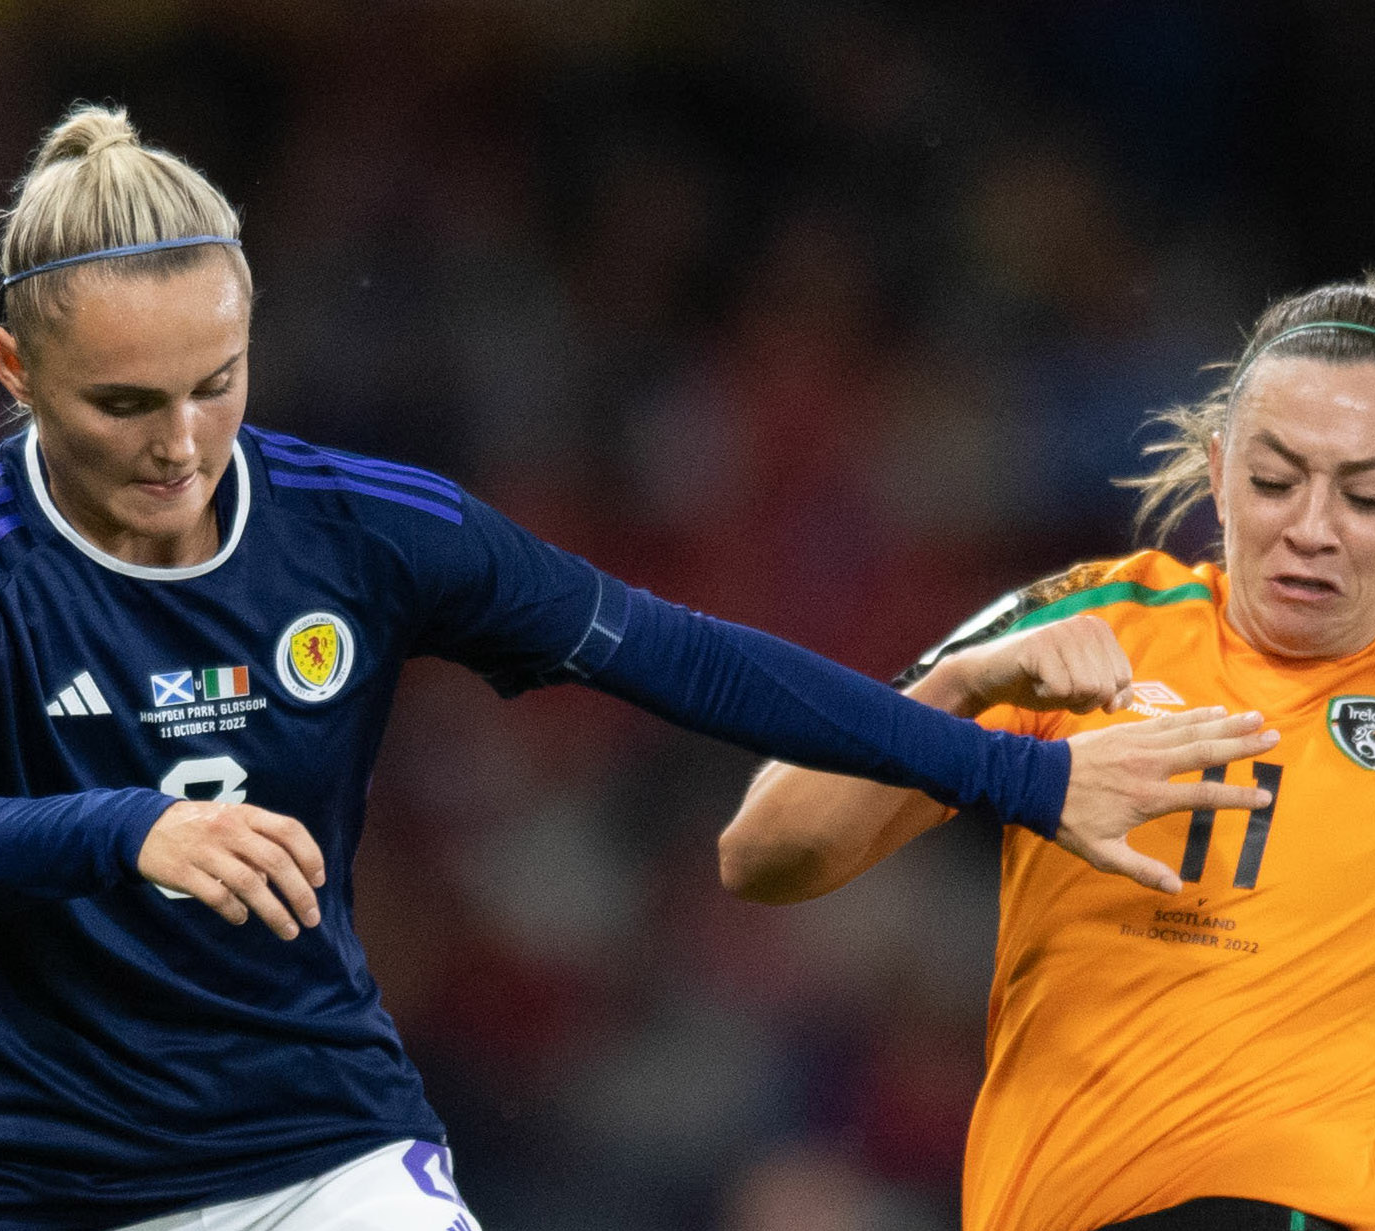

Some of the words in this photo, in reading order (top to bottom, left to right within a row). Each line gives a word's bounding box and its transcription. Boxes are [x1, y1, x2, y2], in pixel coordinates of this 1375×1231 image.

[140, 711, 185, 723] HAMPDEN
[187, 705, 218, 719] PARK,
[220, 698, 267, 715] GLASGOW
[159, 727, 172, 738] 11
[173, 722, 216, 737] OCTOBER
[219, 716, 247, 731] 2022
[1179, 761, 1284, 889] 11
[1153, 909, 1236, 931] SCOTLAND
[1147, 926, 1219, 948] OCTOBER
[1225, 938, 1259, 954] 2022
